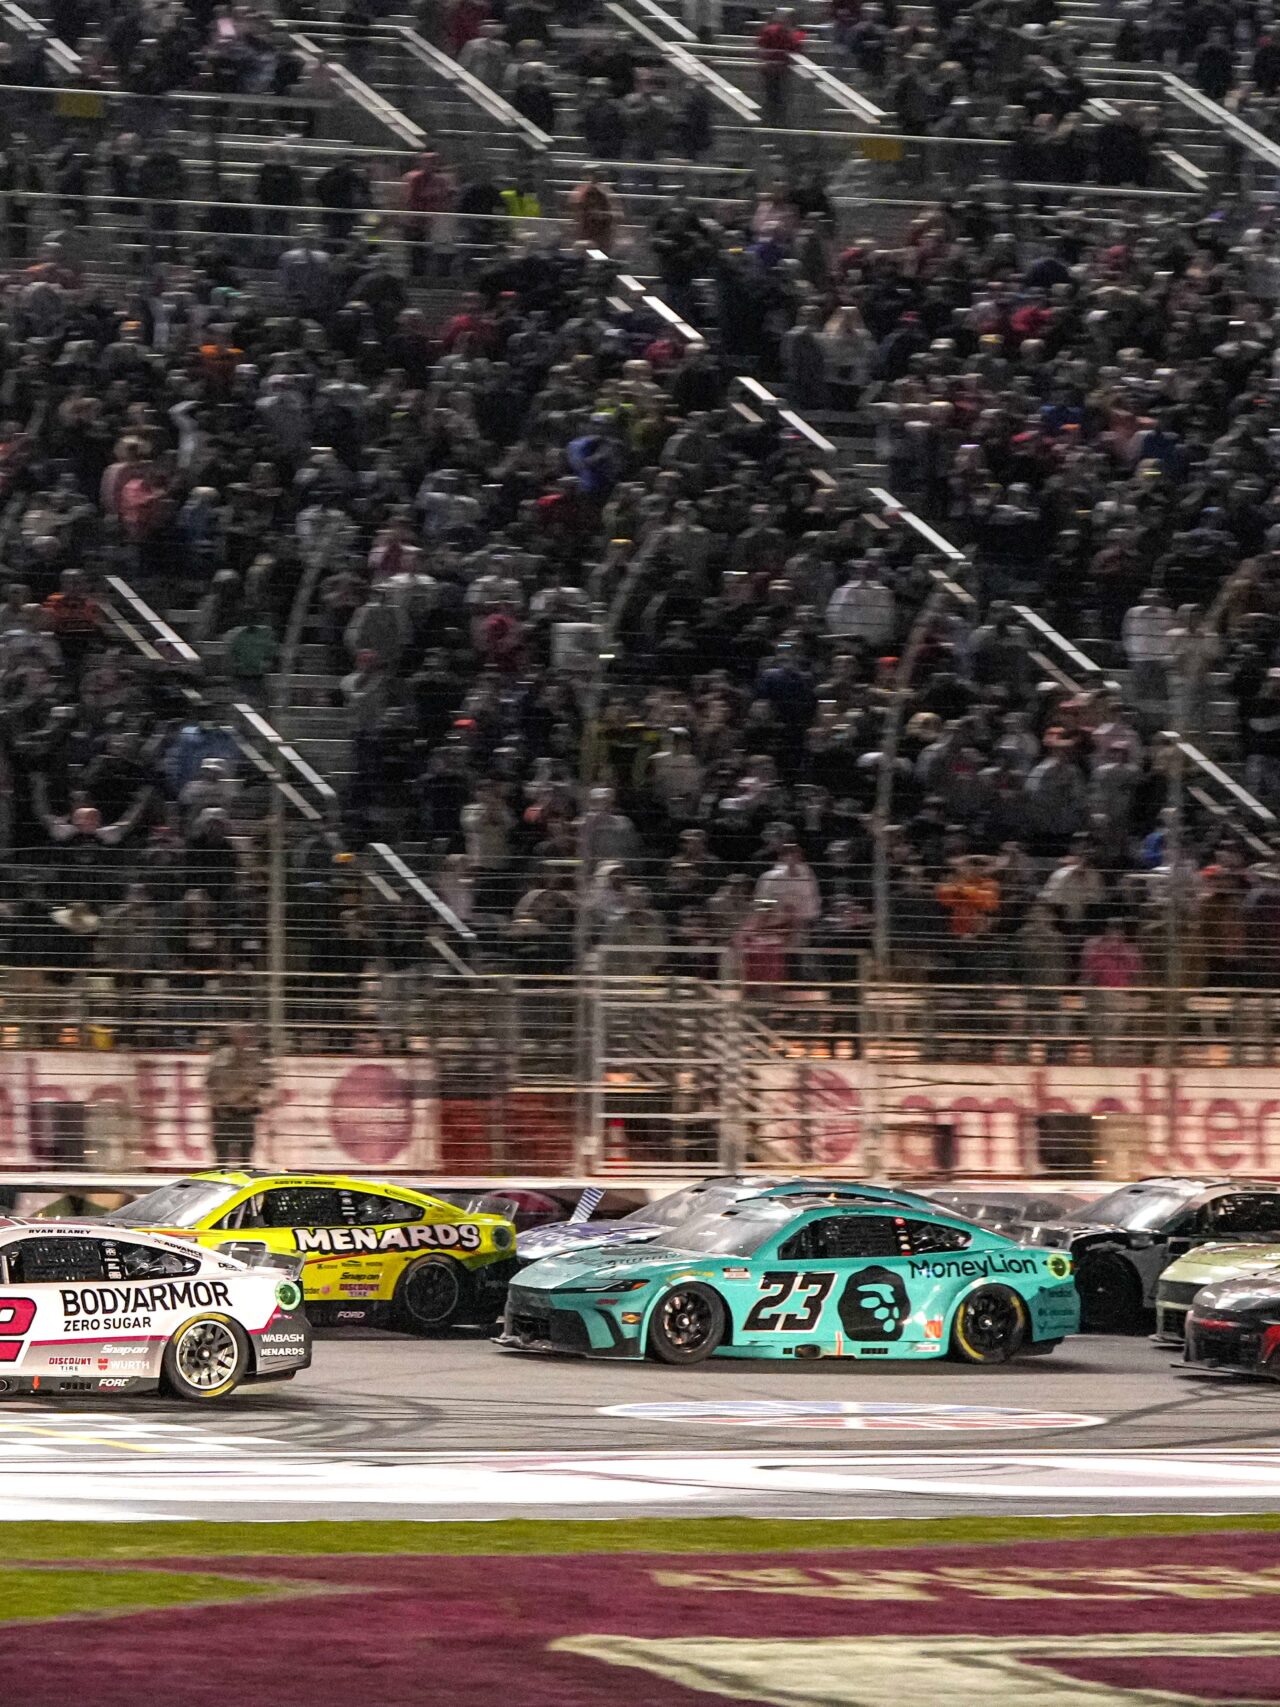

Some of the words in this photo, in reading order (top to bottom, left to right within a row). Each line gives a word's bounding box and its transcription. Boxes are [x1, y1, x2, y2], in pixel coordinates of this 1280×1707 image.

[294, 1224, 482, 1252] MENARDS
[164, 1241, 203, 1257] ADVANCE
[908, 1254, 1038, 1278] MoneyLion
[59, 1281, 233, 1317] BODYARMOR
[743, 1271, 837, 1332] 23
[63, 1319, 100, 1332] ZERO
[104, 1317, 152, 1330] SUGAR
[261, 1333, 305, 1343] WABASH
[100, 1344, 149, 1355] Snap-on
[261, 1347, 305, 1357] MENARDS
[48, 1357, 92, 1366] DISCOUNT
